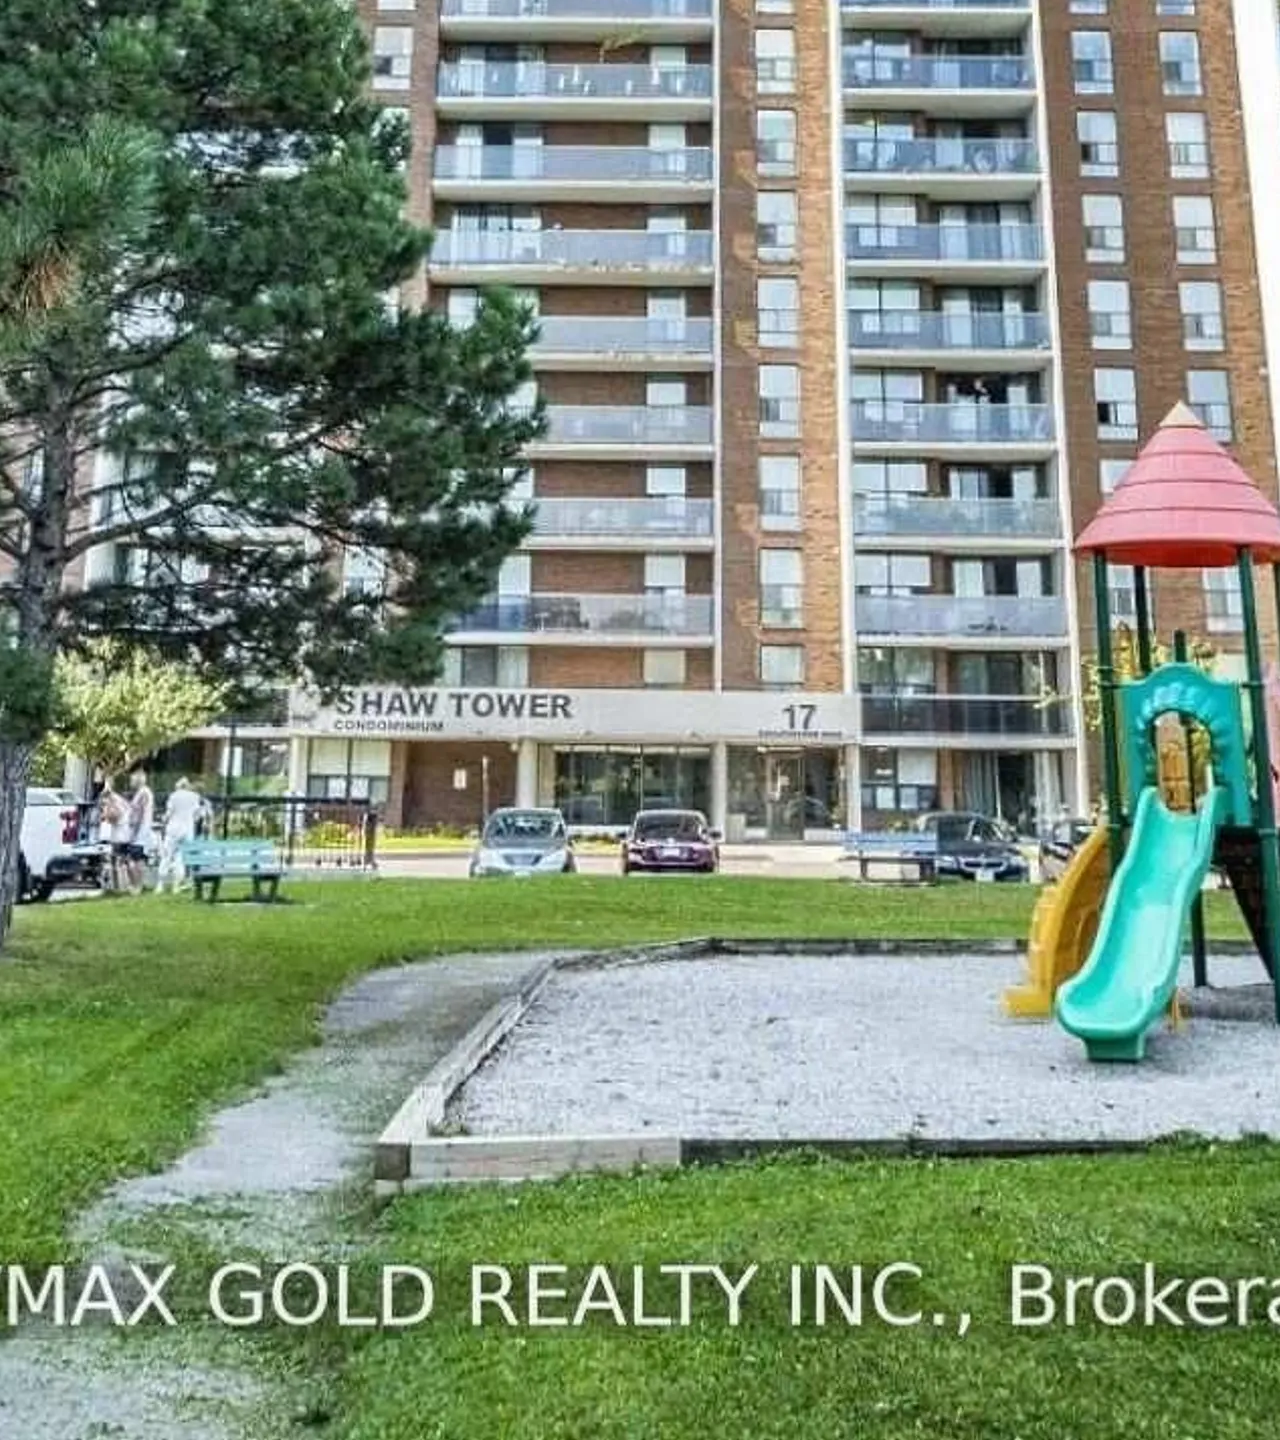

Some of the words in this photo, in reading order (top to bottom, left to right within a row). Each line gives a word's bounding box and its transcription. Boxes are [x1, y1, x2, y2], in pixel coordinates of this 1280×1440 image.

[336, 690, 438, 716] SHAW
[448, 692, 573, 718] TOWER
[782, 704, 818, 730] 17
[333, 719, 444, 732] CONDOMINIUM
